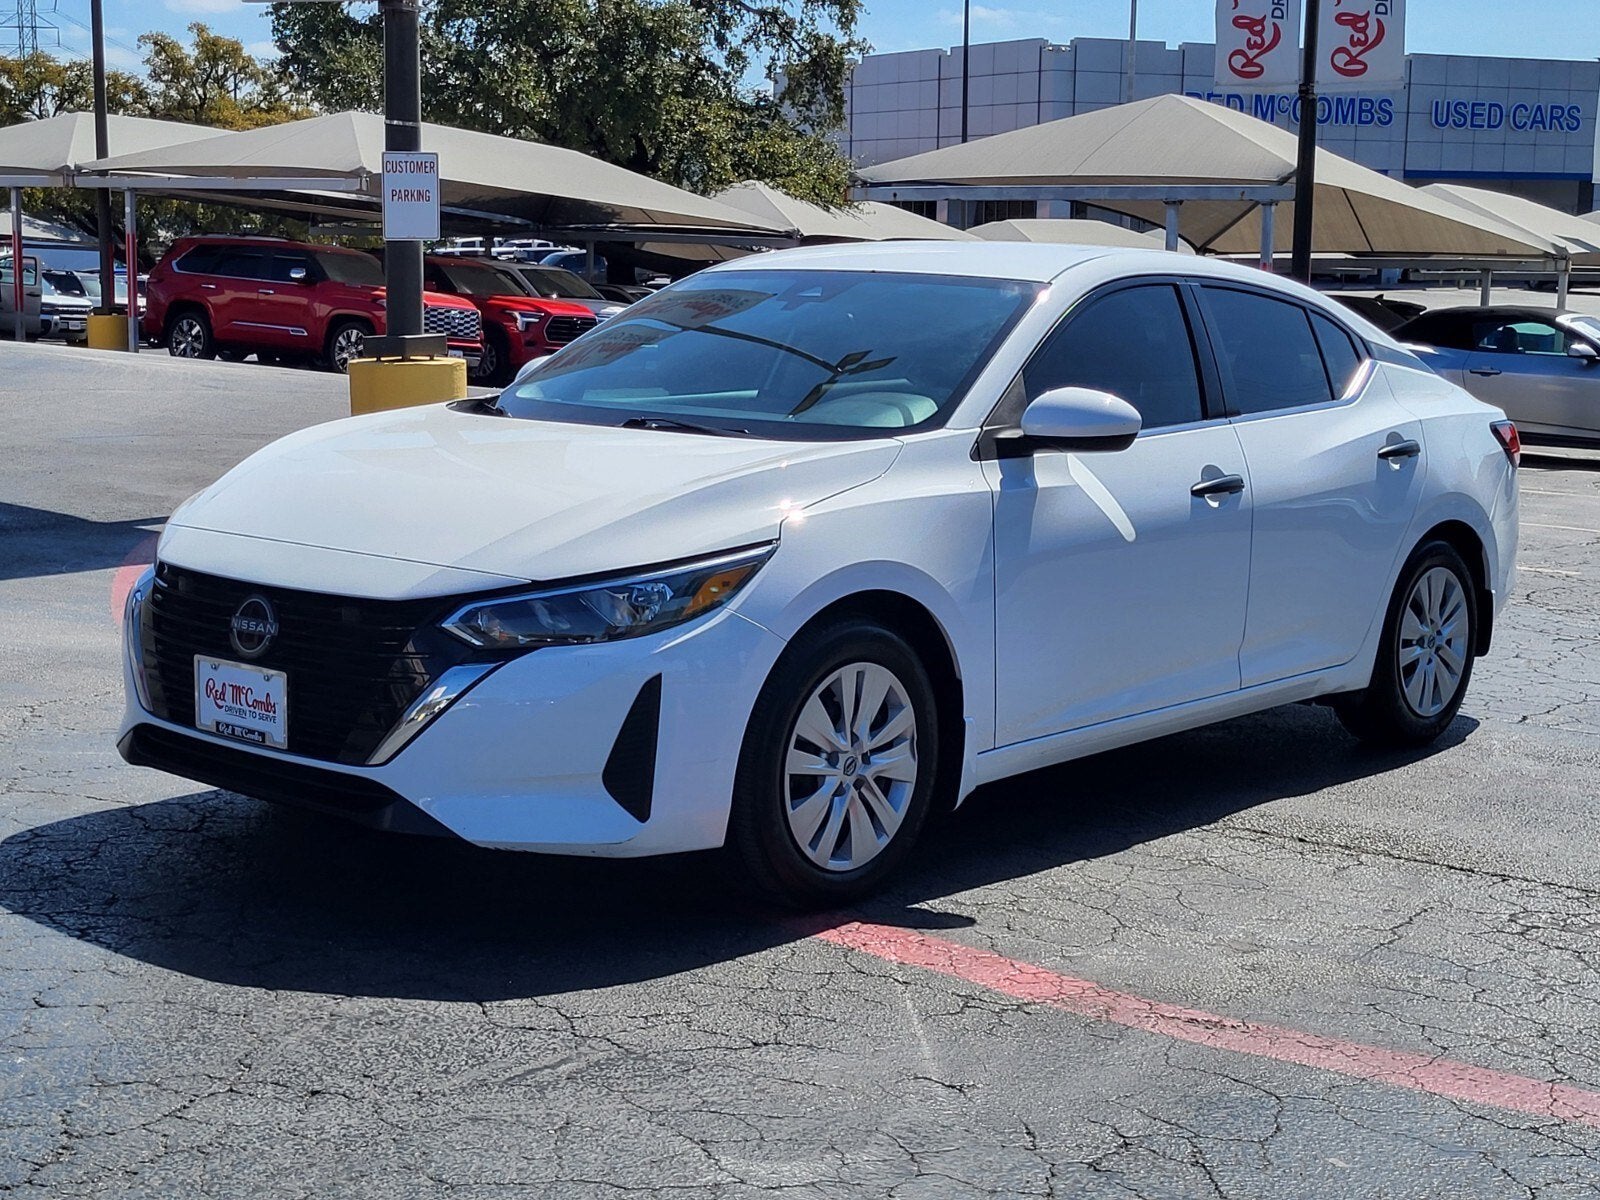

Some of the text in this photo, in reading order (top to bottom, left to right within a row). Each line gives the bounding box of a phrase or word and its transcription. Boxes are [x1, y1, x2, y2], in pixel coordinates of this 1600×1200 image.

[1228, 14, 1281, 79] Red
[1331, 10, 1385, 77] Red
[1433, 100, 1582, 132] USED CARS
[385, 160, 436, 174] CUSTOMER
[391, 188, 431, 203] PARKING
[231, 616, 276, 635] NISSAN
[205, 677, 277, 715] Red McCombs
[224, 704, 277, 725] DRIVEN TO SERVE
